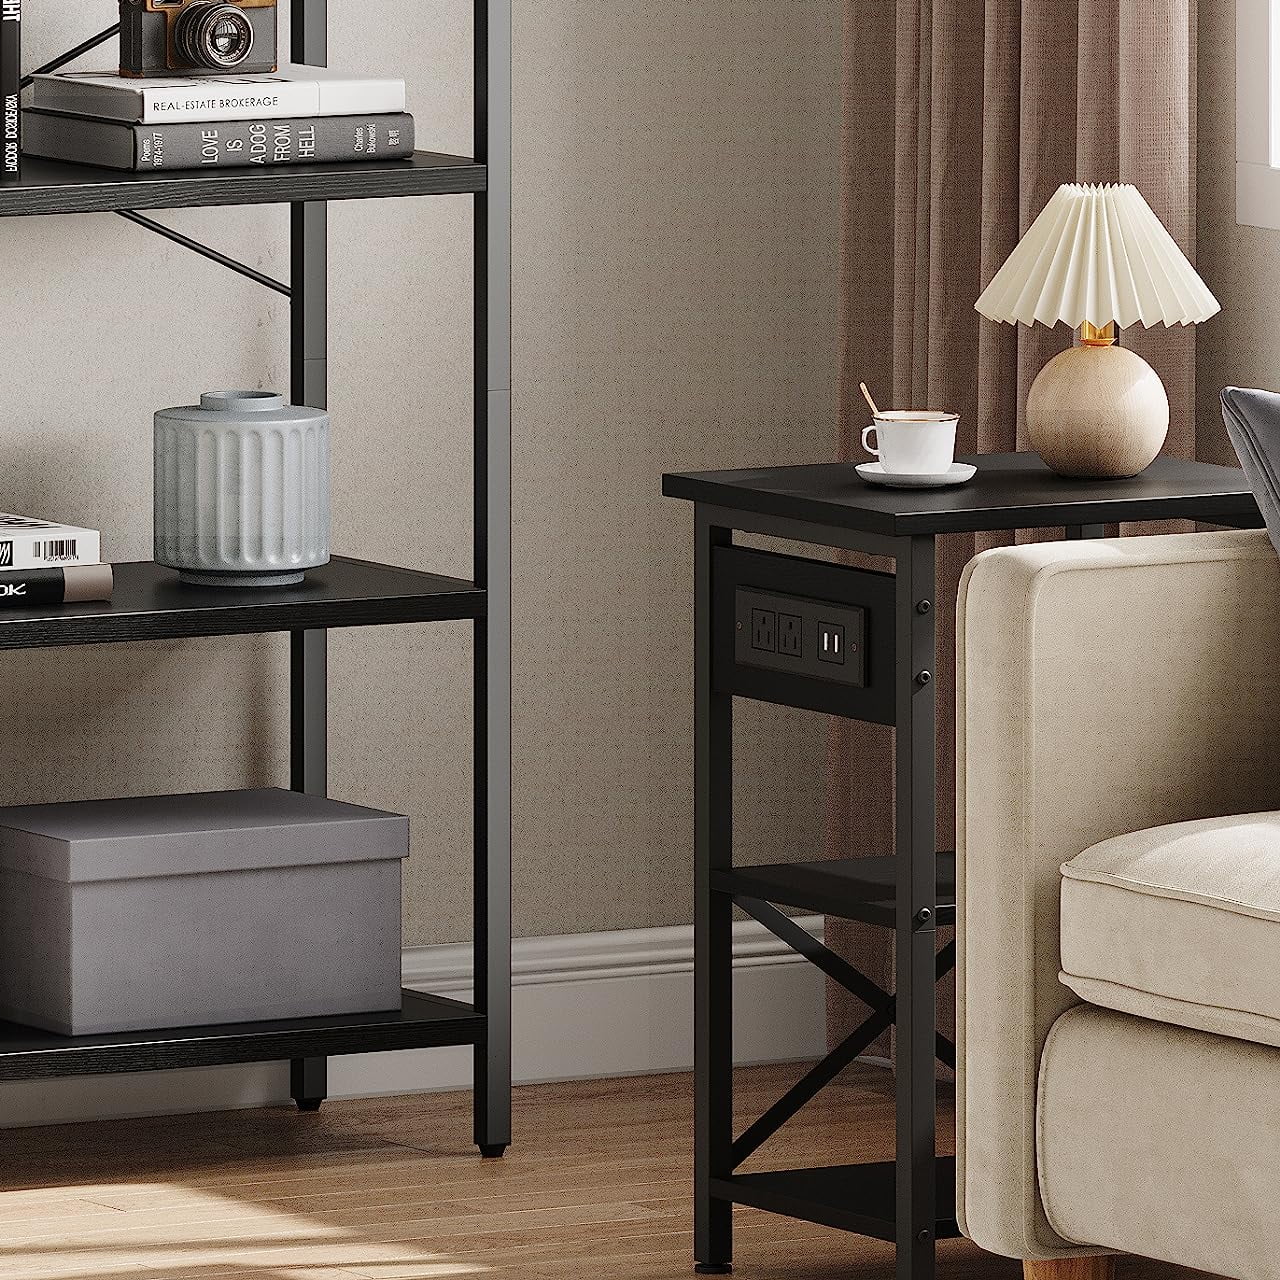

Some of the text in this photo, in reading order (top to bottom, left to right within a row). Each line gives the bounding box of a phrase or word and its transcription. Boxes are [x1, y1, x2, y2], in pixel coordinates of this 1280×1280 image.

[153, 96, 279, 112] REAL-ESTATE BROKERAGE
[141, 138, 151, 162] Poems
[153, 132, 163, 167] 1974-1977
[201, 130, 219, 164] LOVE
[226, 139, 243, 152] IS
[249, 124, 267, 153] DOG
[273, 124, 291, 162] FROM
[298, 125, 315, 158] HELL
[354, 127, 364, 152] Charles
[366, 123, 376, 153] Bukowski
